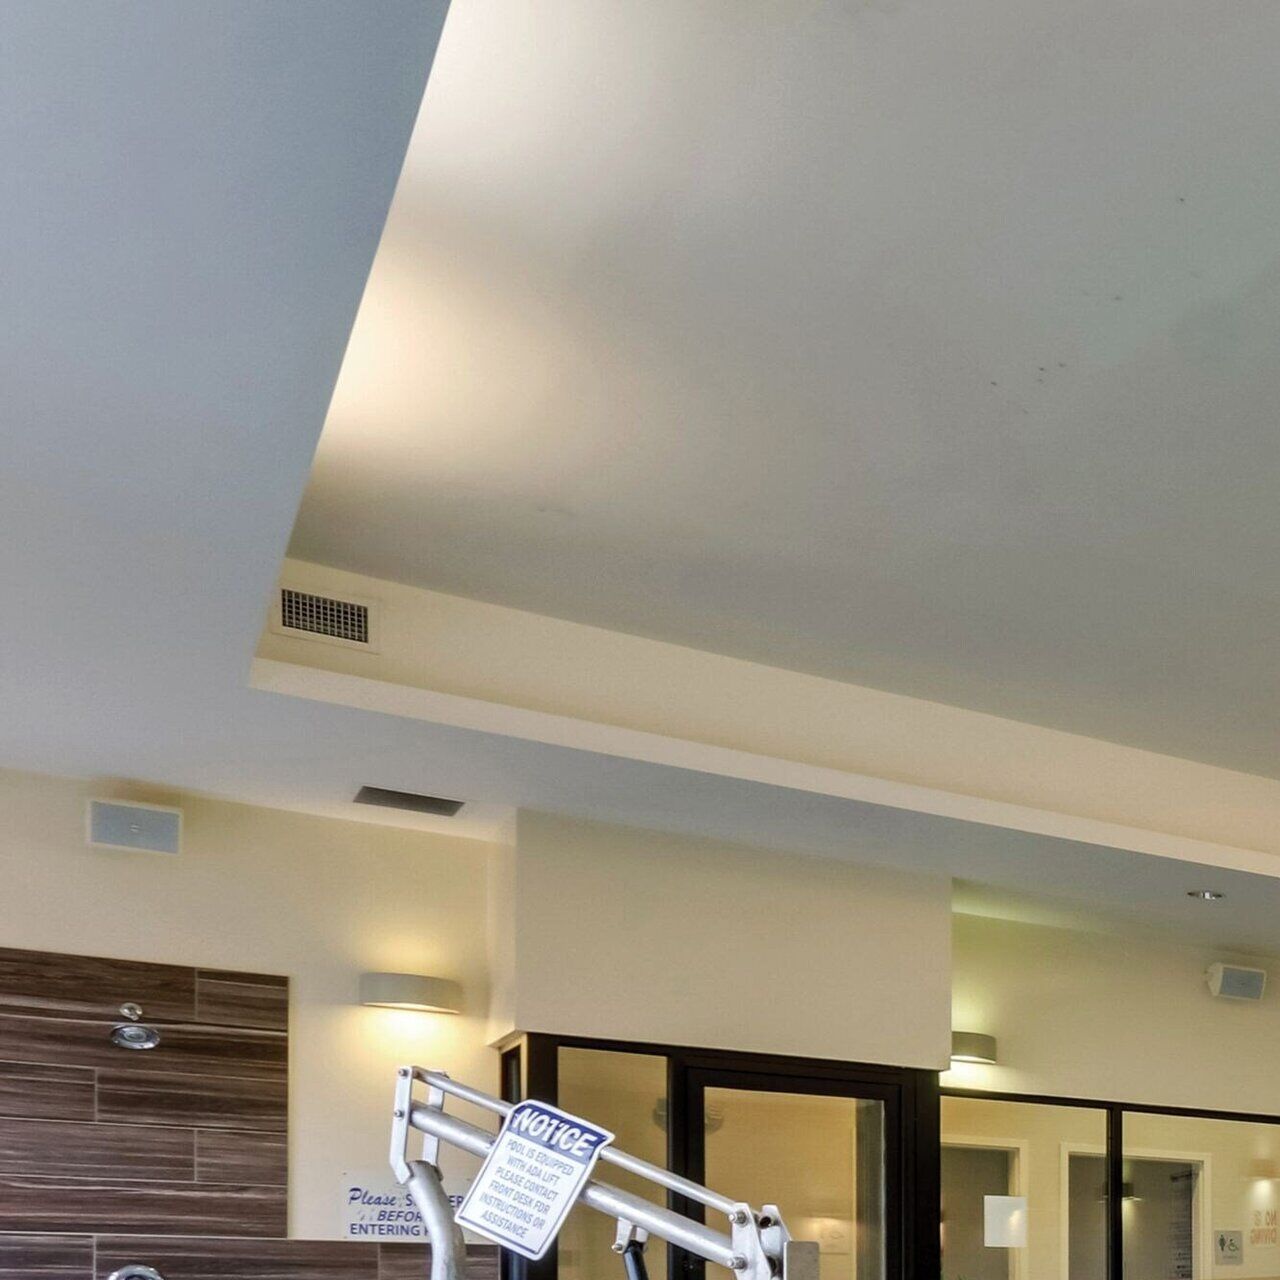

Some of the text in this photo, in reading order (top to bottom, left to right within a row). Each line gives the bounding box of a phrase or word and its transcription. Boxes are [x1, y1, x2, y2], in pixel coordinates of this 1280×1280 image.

[512, 1108, 598, 1157] NOTICE
[506, 1139, 525, 1154] POOL
[525, 1147, 536, 1159] IS
[495, 1166, 560, 1203] PLEASE CONTACT
[507, 1156, 560, 1185] WITH ADA LIFT
[348, 1187, 397, 1206] Please
[489, 1180, 551, 1216] FRONT DESK FOR
[377, 1210, 423, 1222] BEFOR
[480, 1192, 546, 1231] INSTRUCTIONS OR
[480, 1210, 530, 1239] ASSISTANCE
[350, 1223, 420, 1237] ENTERING
